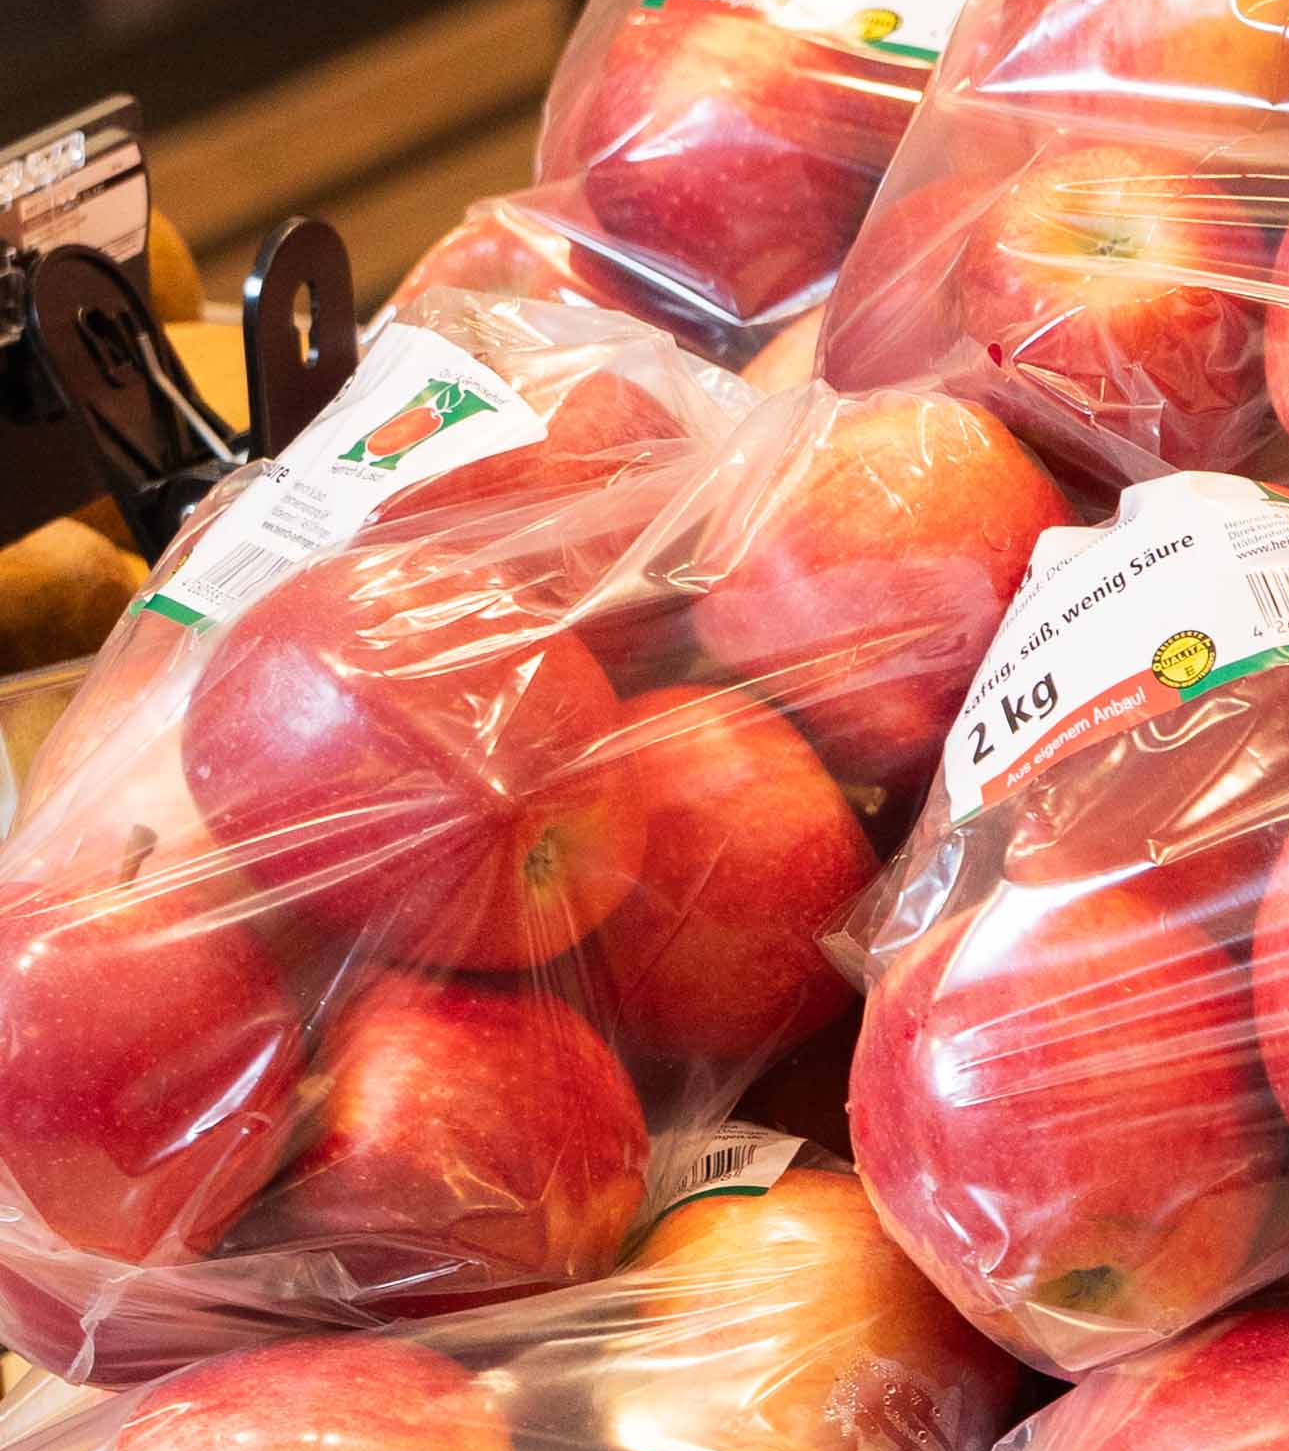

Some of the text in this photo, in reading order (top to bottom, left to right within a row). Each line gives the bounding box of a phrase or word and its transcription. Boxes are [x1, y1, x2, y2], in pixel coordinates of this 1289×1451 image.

[1020, 621, 1061, 660] süß,
[1061, 570, 1127, 624] wenig
[1128, 534, 1196, 577] Säure
[1252, 625, 1263, 637] 4
[967, 671, 1060, 766] 2 kg
[1006, 685, 1147, 788] Aus eigenem Anbau!
